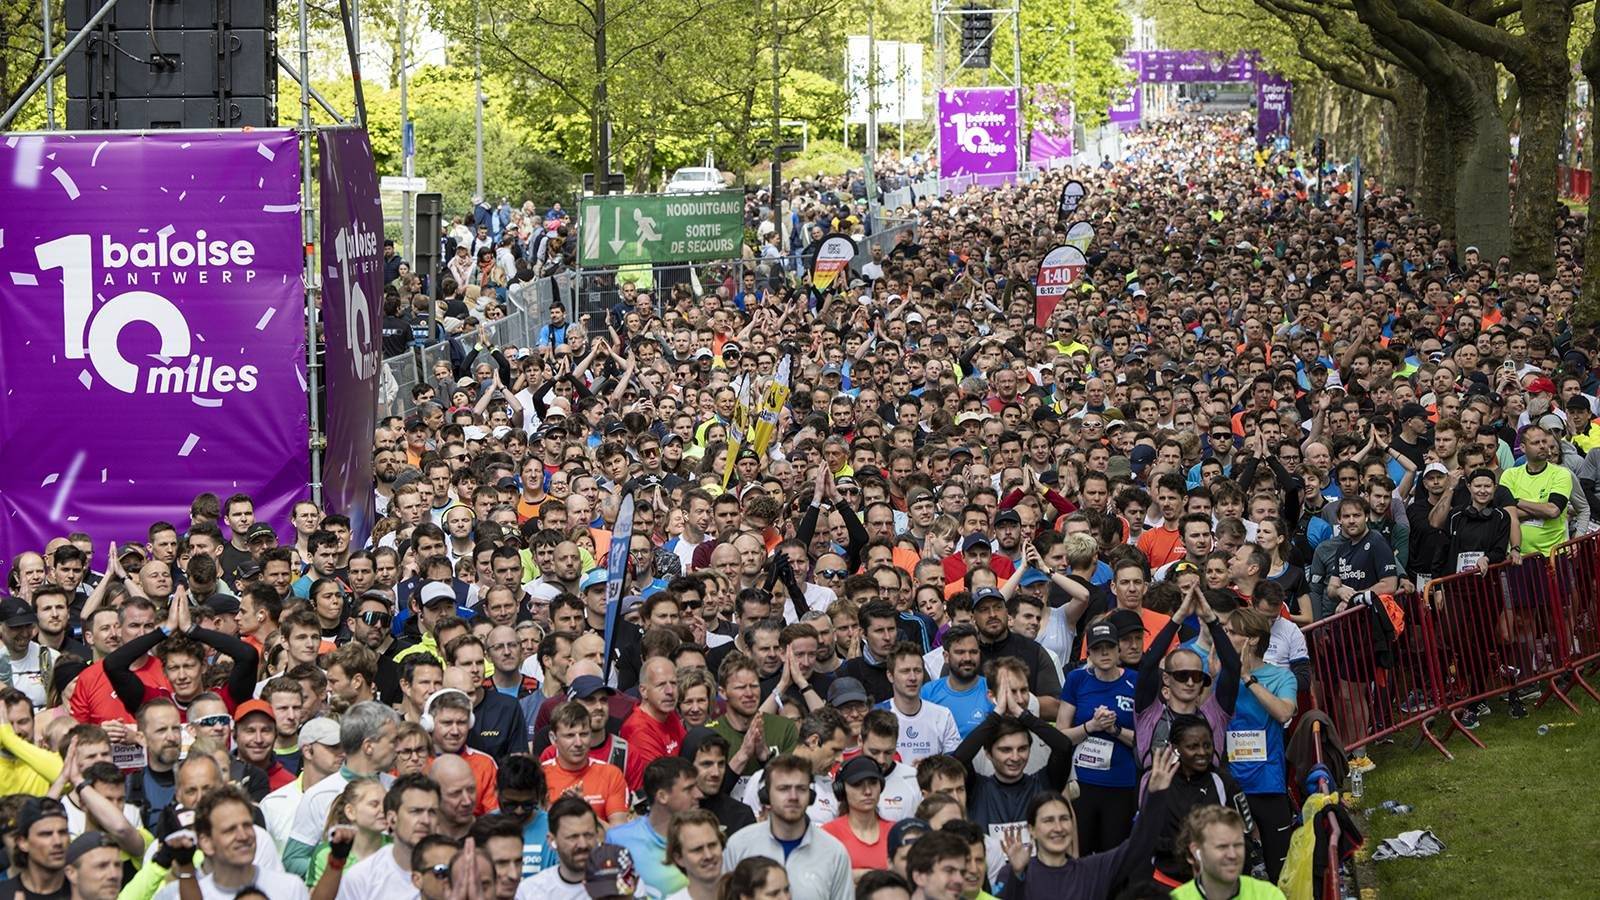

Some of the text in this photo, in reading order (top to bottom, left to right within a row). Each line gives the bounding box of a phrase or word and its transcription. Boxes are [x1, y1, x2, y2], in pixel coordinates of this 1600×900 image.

[1262, 84, 1287, 94] Enjoy
[666, 201, 740, 216] NOODUITGANG
[686, 224, 721, 238] SORTIE
[102, 229, 256, 268] baloise
[670, 238, 734, 253] DE SECOURS
[103, 270, 256, 286] ANTWERP
[1043, 267, 1071, 284] 1:40
[1040, 287, 1055, 295] 6:12
[146, 354, 260, 394] miles
